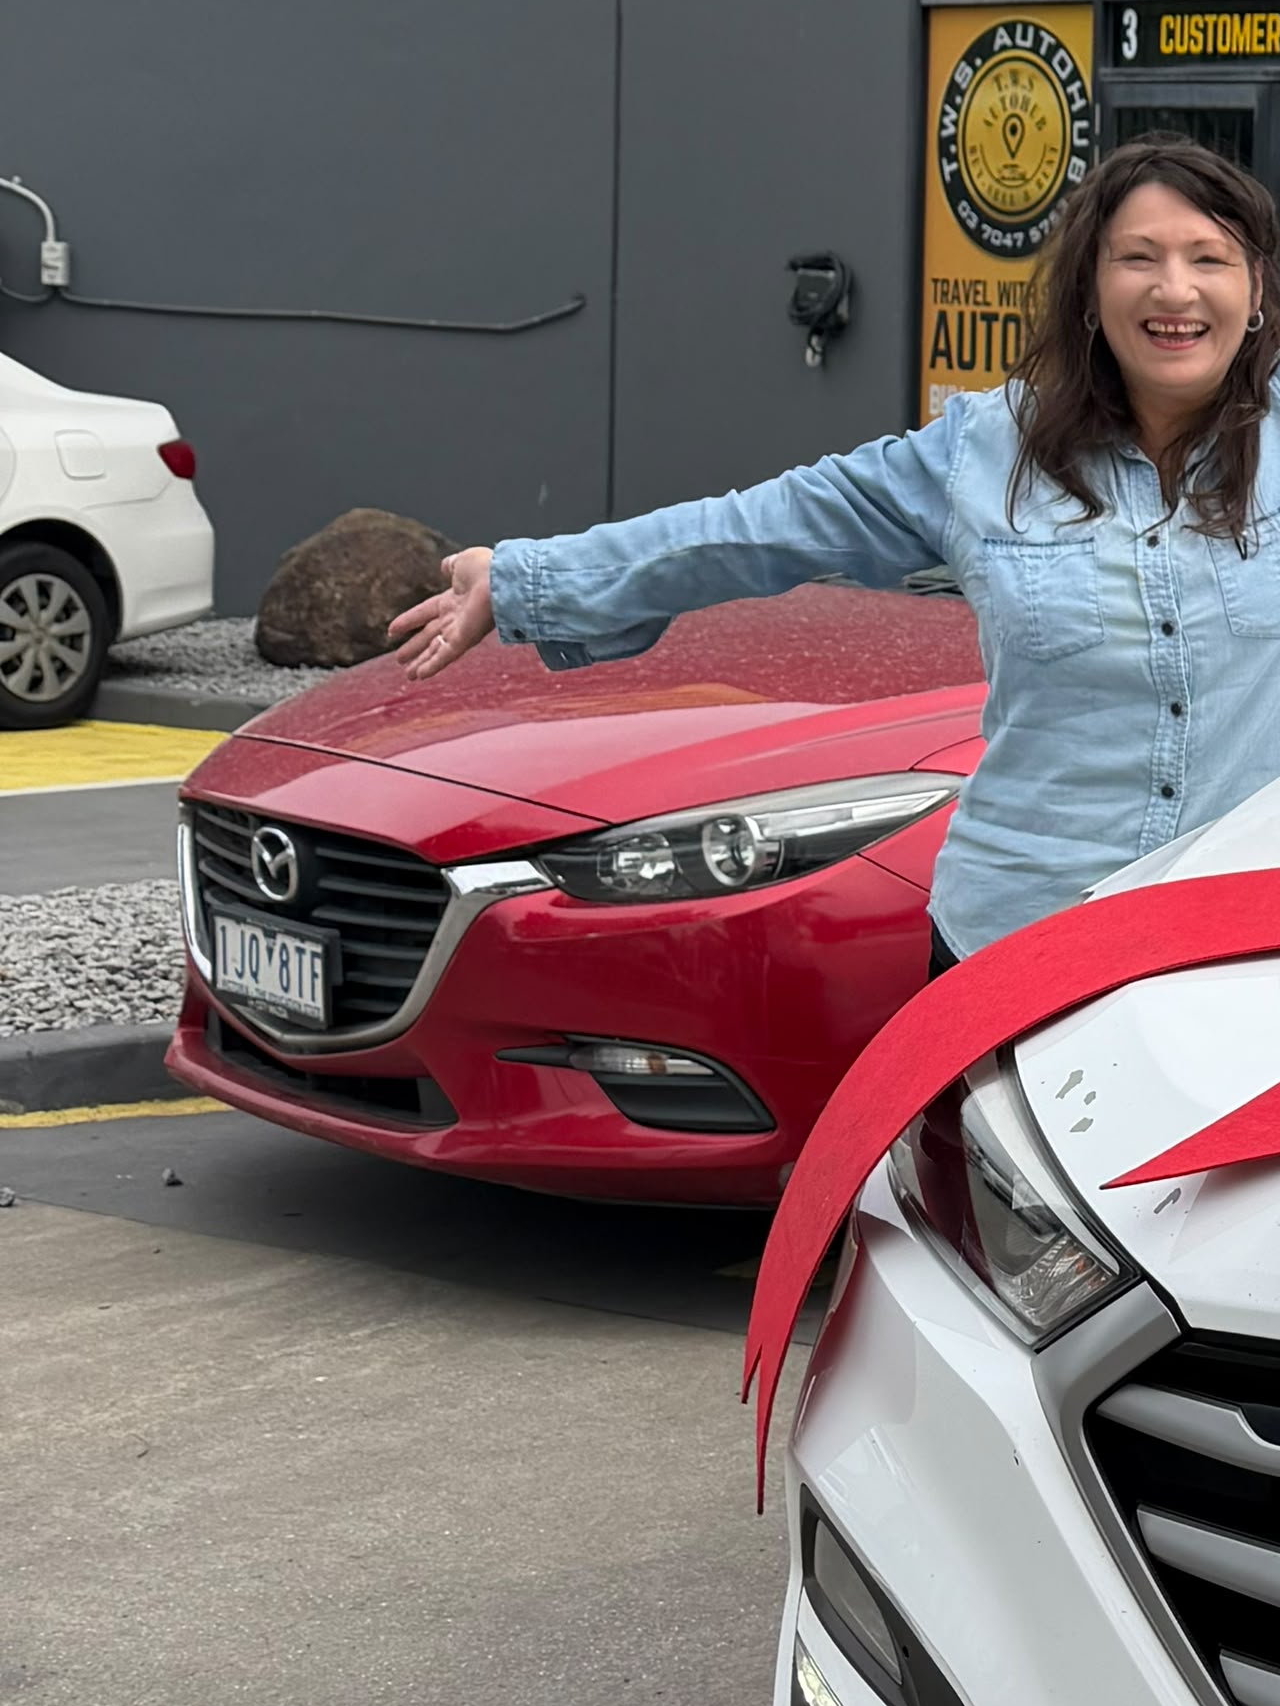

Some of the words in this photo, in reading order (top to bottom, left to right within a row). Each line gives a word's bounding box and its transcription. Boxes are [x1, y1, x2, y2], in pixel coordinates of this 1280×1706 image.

[1122, 8, 1138, 60] 3
[992, 22, 1090, 183] AUTOHUB
[931, 278, 993, 306] TRAVEL
[996, 280, 1034, 307] WIT
[278, 942, 321, 1003] 8TF
